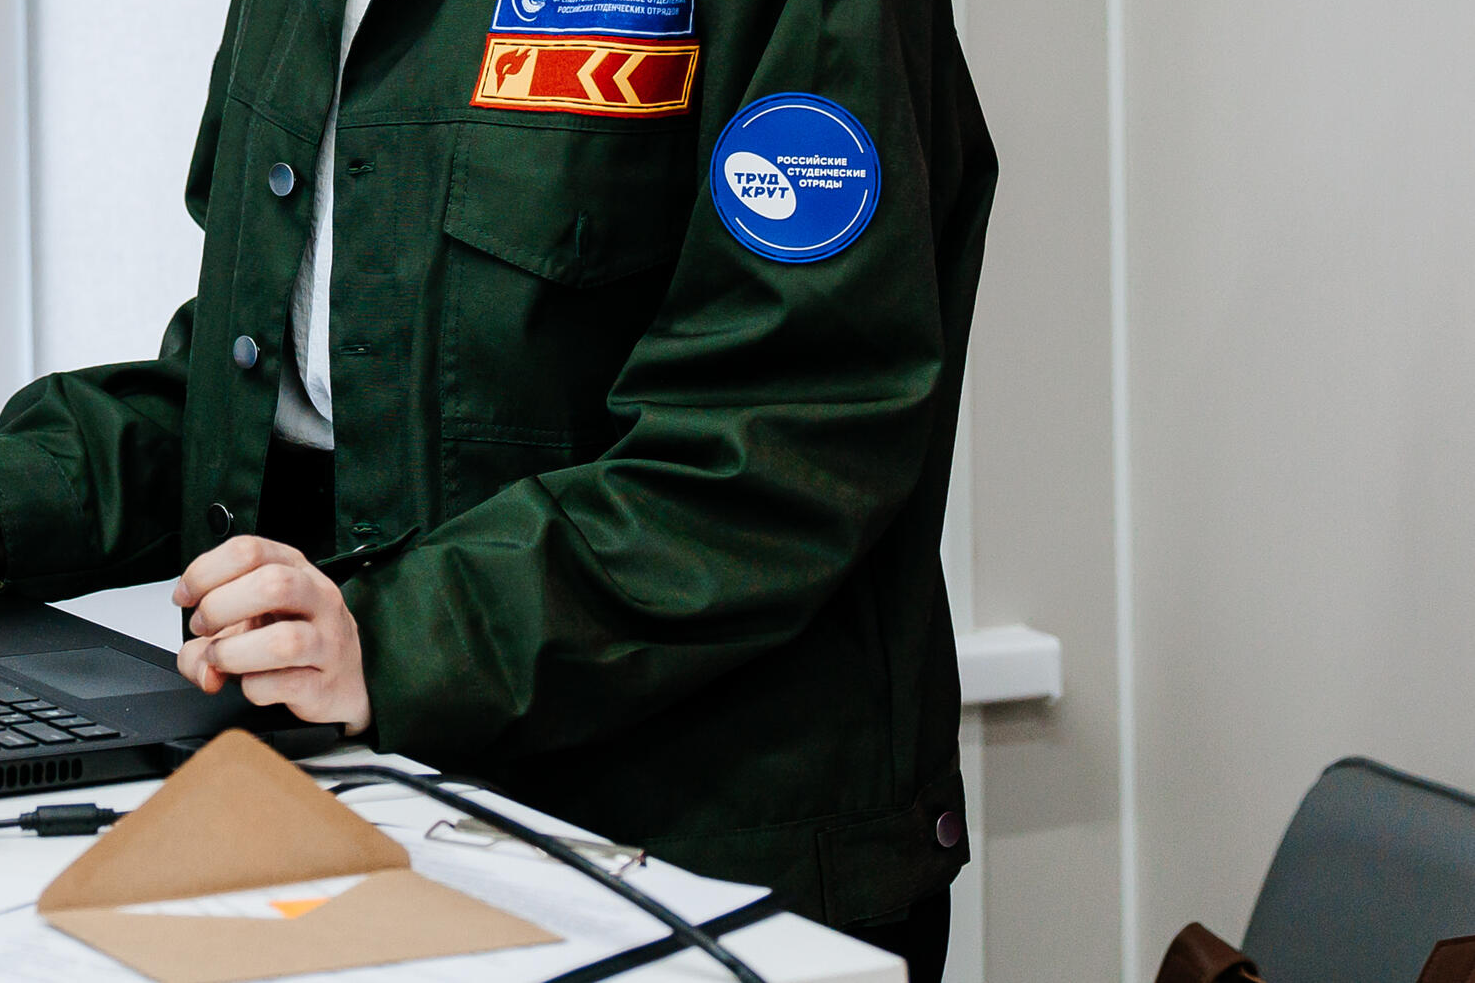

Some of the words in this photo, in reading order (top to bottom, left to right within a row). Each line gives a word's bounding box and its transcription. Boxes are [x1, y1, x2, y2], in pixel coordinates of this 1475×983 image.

[593, 3, 645, 15] СТУДЕНЧЕСКИХ
[777, 155, 847, 166] РОССИЙСКИЕ
[787, 167, 866, 178] СТУДЕНЧЕСКИЕ
[734, 172, 780, 186] ТРУД
[799, 179, 843, 189] ОТРЯДЫ
[741, 186, 789, 199] КРУТ
